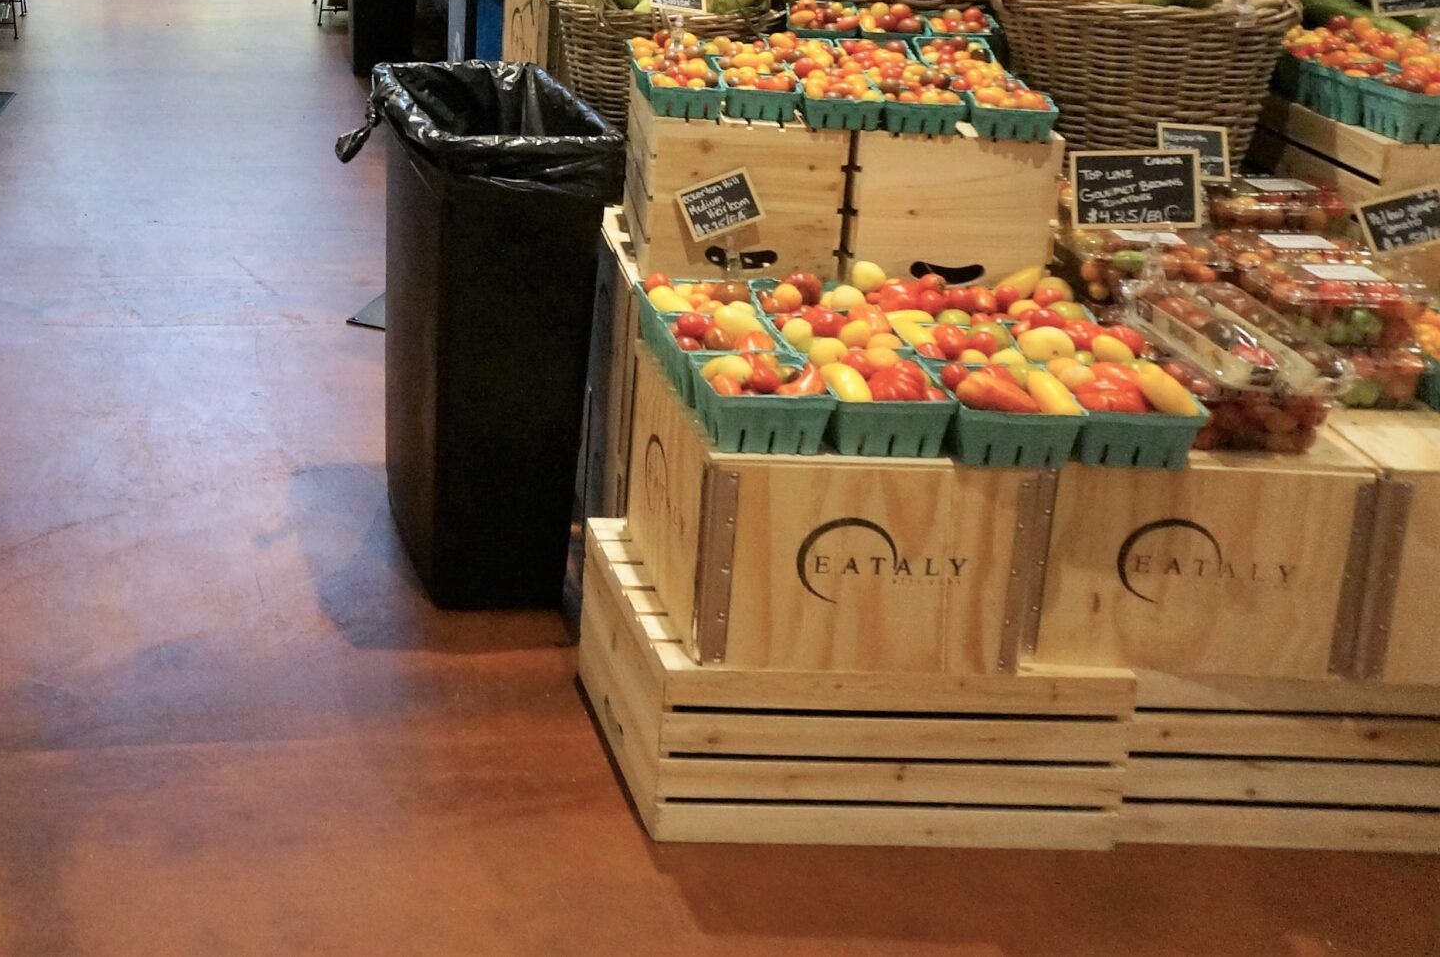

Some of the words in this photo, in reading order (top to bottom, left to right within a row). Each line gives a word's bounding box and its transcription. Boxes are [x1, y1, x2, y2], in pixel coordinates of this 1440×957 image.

[1143, 156, 1184, 166] CANADA
[1078, 169, 1104, 181] TOP
[1105, 169, 1134, 181] LINE
[1079, 183, 1137, 203] GOURMET
[814, 556, 968, 577] EATALY
[1133, 554, 1297, 584] EATALY
